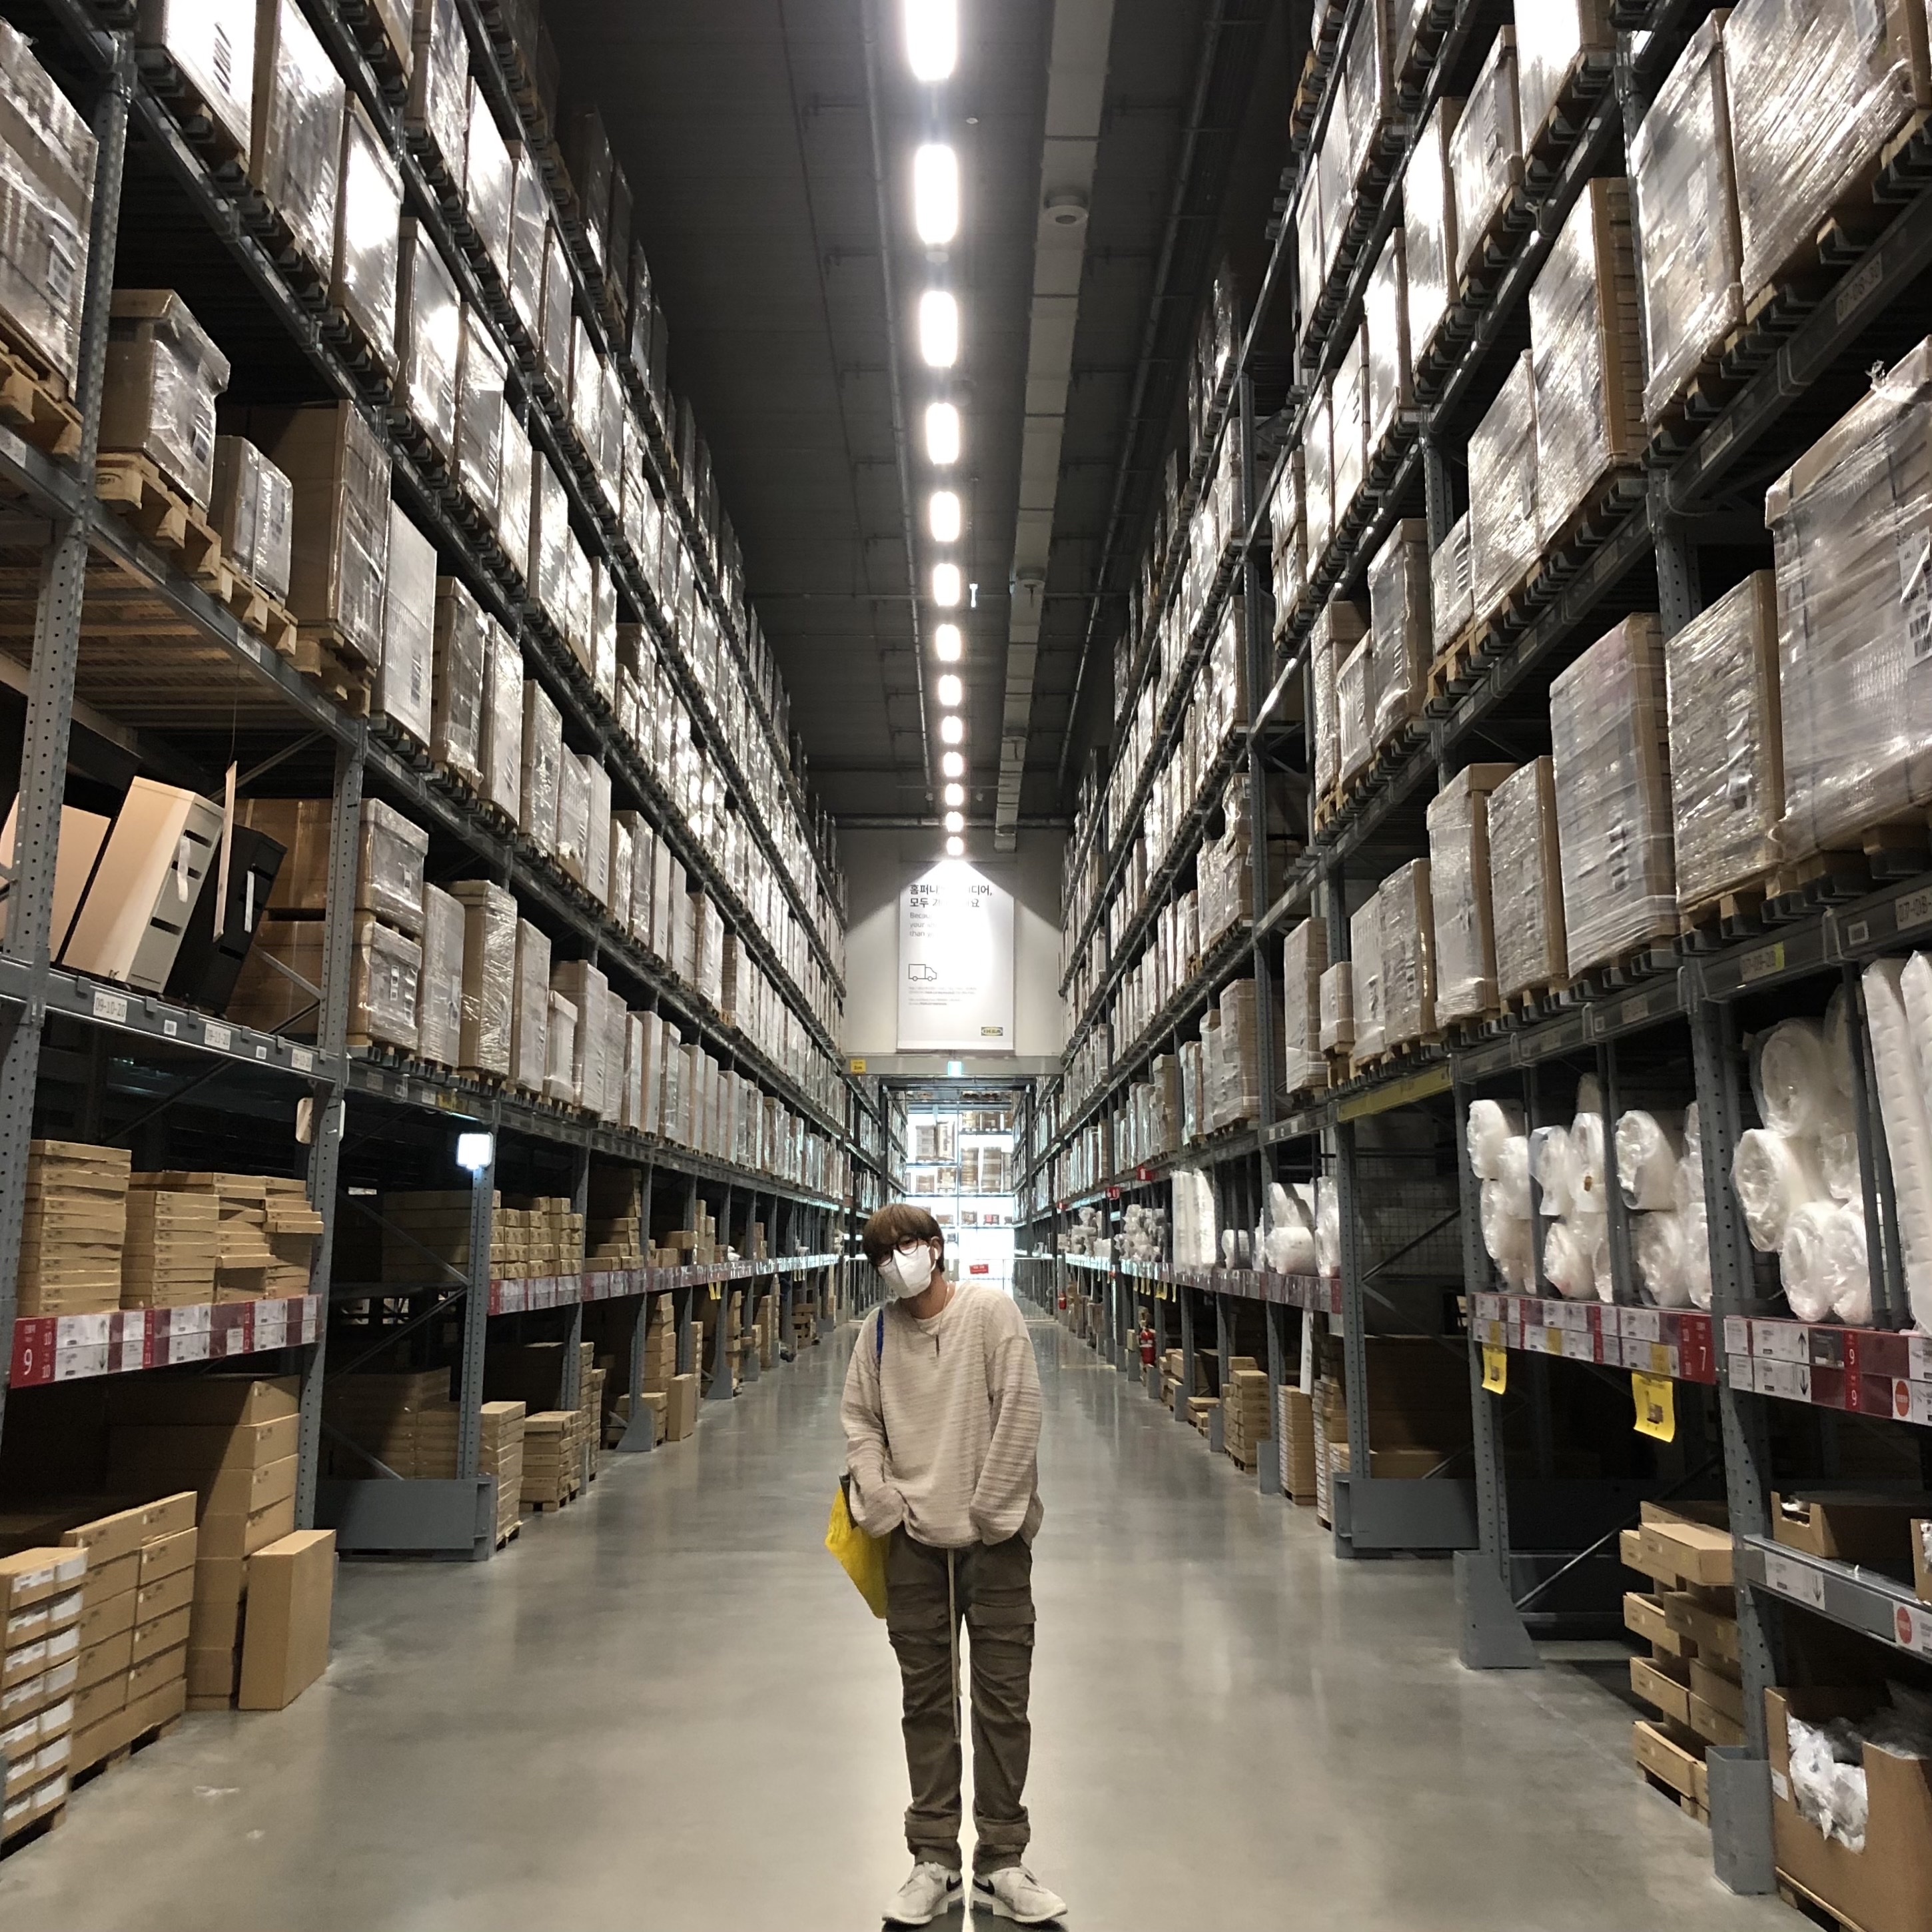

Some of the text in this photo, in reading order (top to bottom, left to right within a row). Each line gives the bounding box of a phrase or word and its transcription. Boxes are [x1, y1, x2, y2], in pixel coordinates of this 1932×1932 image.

[910, 897, 929, 908] 모두
[95, 997, 126, 1017] 09-10-20
[43, 1331, 53, 1346] 10
[24, 1348, 33, 1375] 9
[1699, 1346, 1706, 1372] 7
[1849, 1348, 1855, 1365] 9
[41, 1364, 51, 1378] 10
[1851, 1389, 1858, 1406] 9
